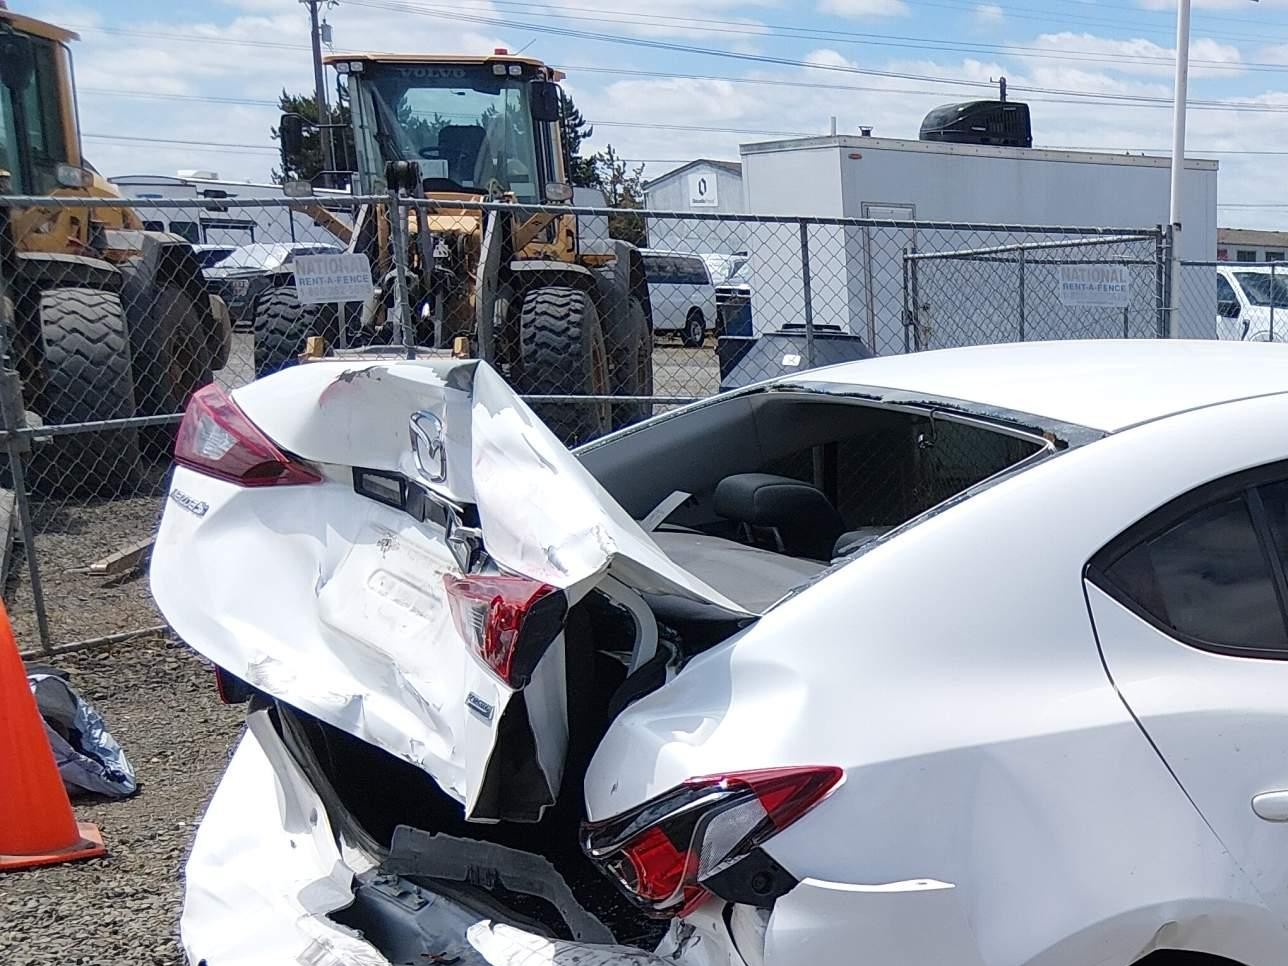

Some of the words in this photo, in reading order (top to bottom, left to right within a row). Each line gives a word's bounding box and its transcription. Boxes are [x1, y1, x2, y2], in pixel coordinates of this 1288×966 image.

[398, 68, 466, 78] VOLVO
[295, 256, 370, 275] NATIONAL
[299, 274, 369, 286] RENT-A-FENCE
[1061, 267, 1127, 283] NATIONAL
[1062, 282, 1126, 292] RENT-A-FENCE
